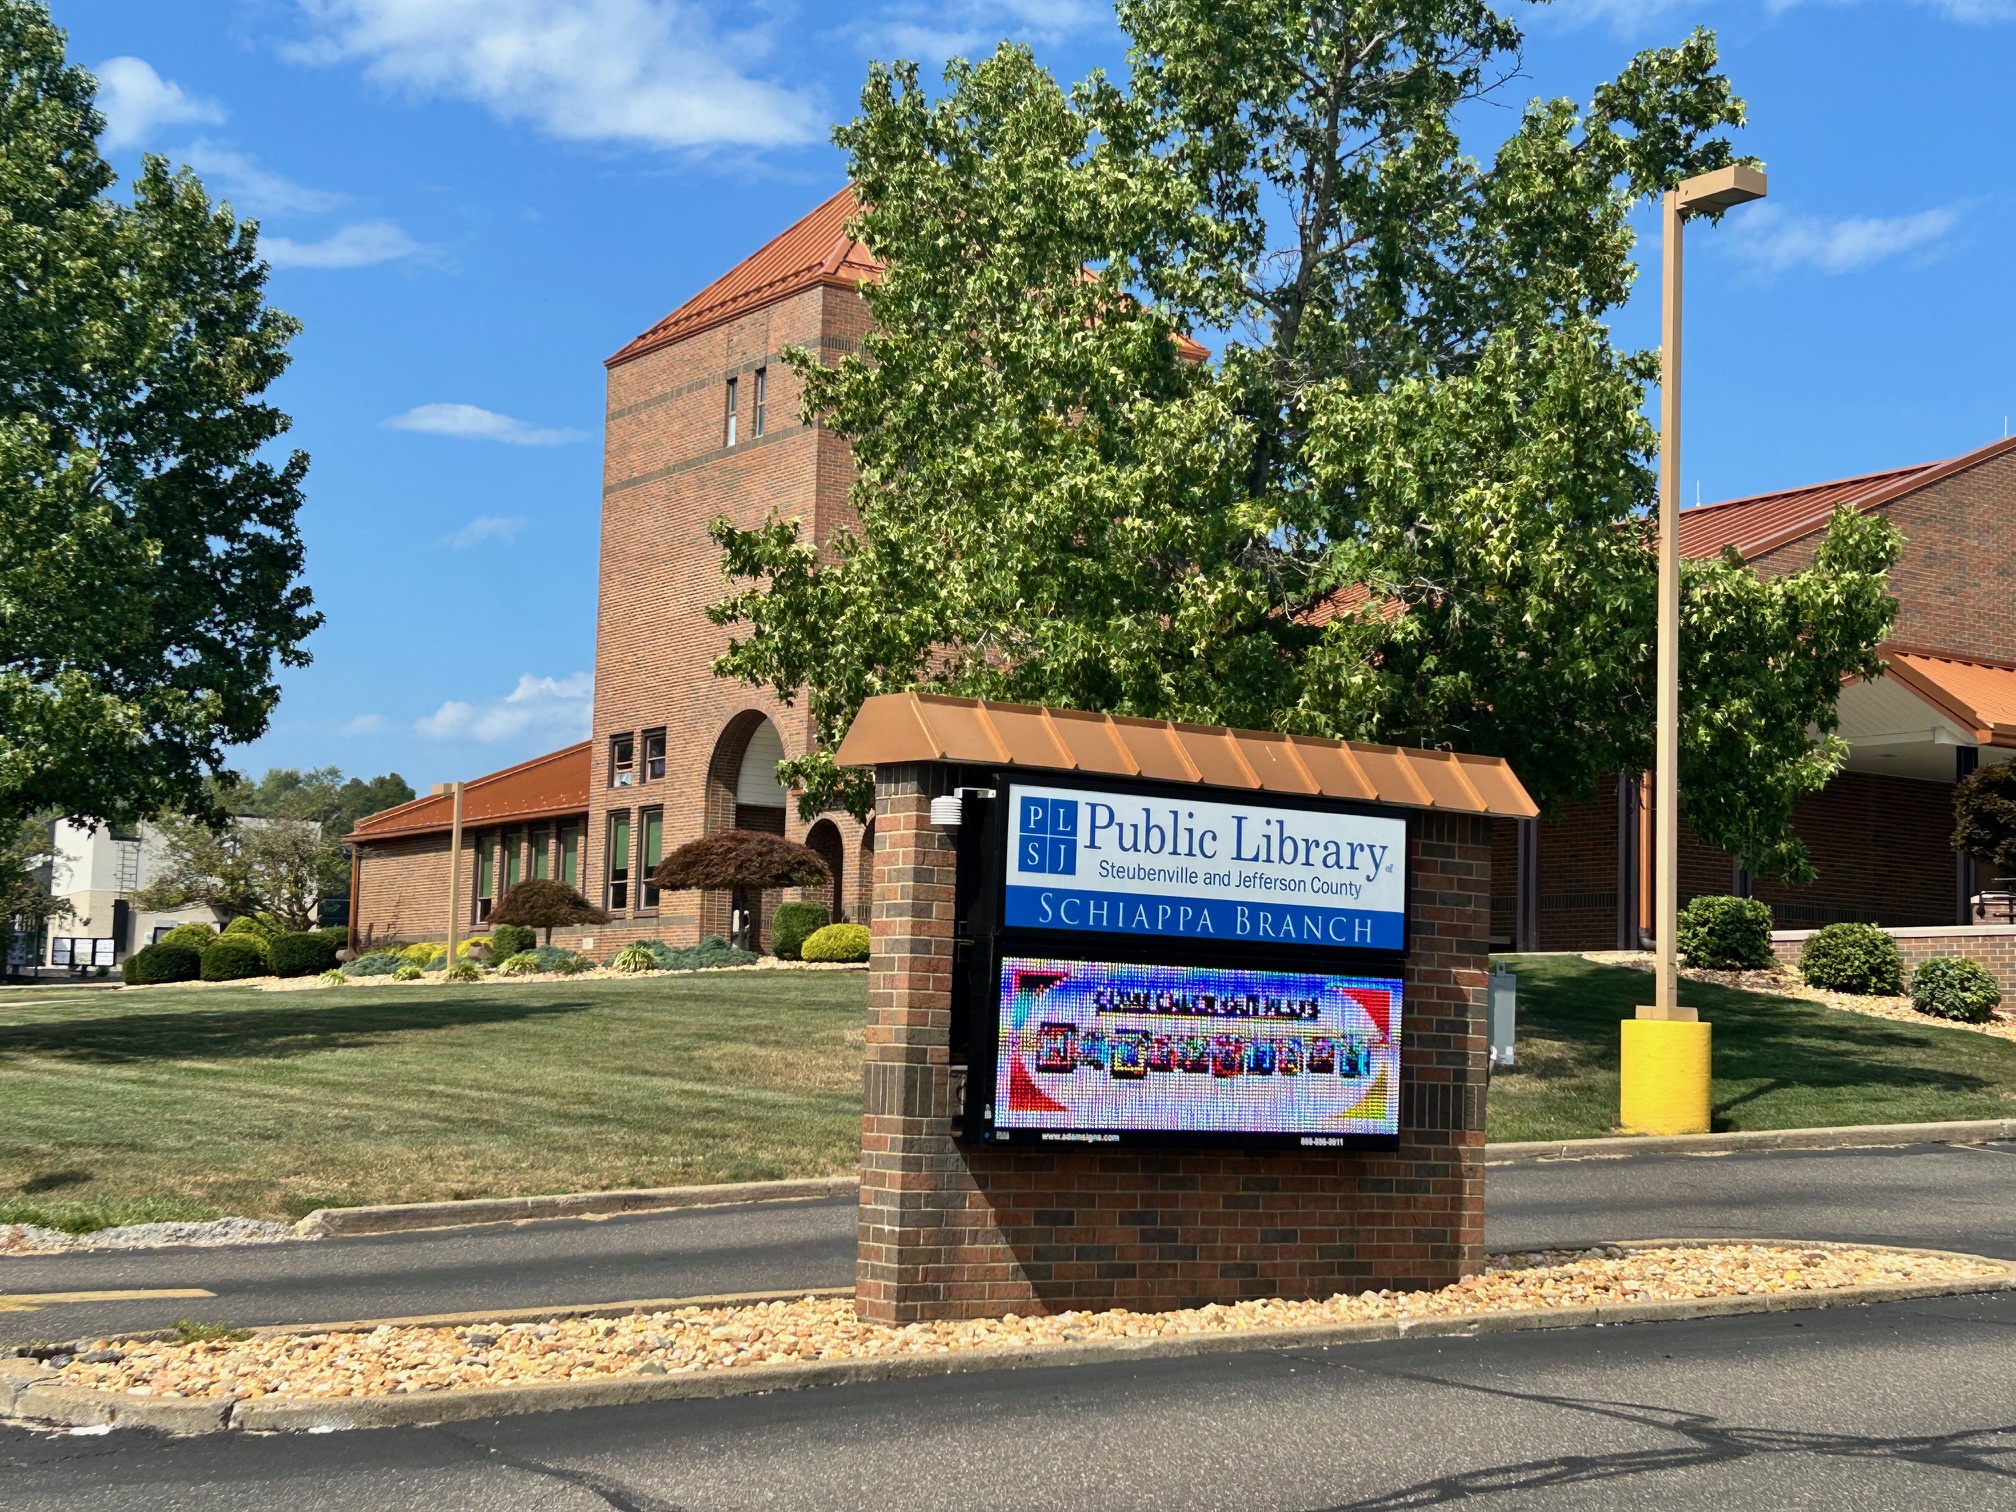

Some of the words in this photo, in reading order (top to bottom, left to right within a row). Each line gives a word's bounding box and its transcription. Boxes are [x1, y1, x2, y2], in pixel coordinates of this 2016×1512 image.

[1083, 801, 1218, 860] Public
[1230, 815, 1389, 883] Library
[1098, 859, 1199, 885] Steubenville
[1203, 869, 1231, 887] and
[1234, 870, 1307, 893] Jefferson
[1310, 875, 1362, 901] County
[1039, 892, 1215, 934] SCHIAPPA
[1234, 899, 1372, 943] BRANCH
